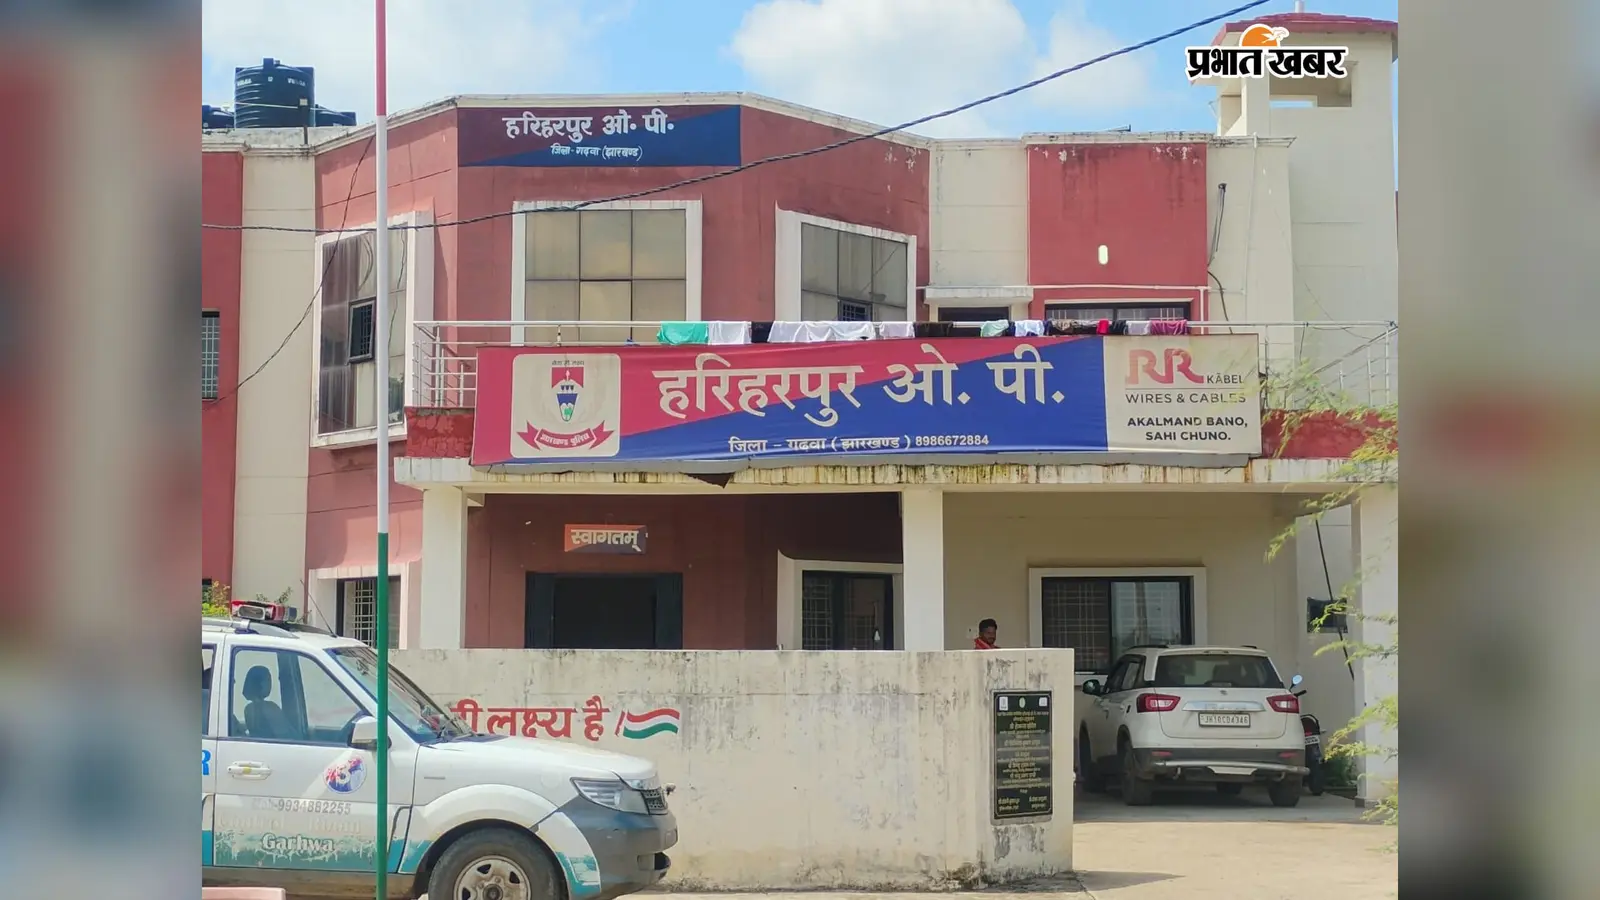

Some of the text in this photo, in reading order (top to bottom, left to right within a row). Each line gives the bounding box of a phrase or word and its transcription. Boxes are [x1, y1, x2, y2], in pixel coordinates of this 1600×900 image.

[502, 111, 593, 142] हरिहरपुर
[1125, 348, 1204, 384] RR
[651, 343, 1066, 428] हरिहरपुर ओ. पी.
[1126, 393, 1246, 404] WIRES & CABLES
[1127, 416, 1248, 428] AKALMAND BANO,
[728, 436, 768, 453] जिला
[840, 437, 900, 452] झारखण्ड
[915, 435, 989, 446] 8986672884
[1145, 431, 1231, 441] SAHI CHUNO.
[571, 529, 642, 552] स्वागतम्
[487, 707, 577, 739] लक्ष्य
[261, 832, 335, 852] Garhwa
